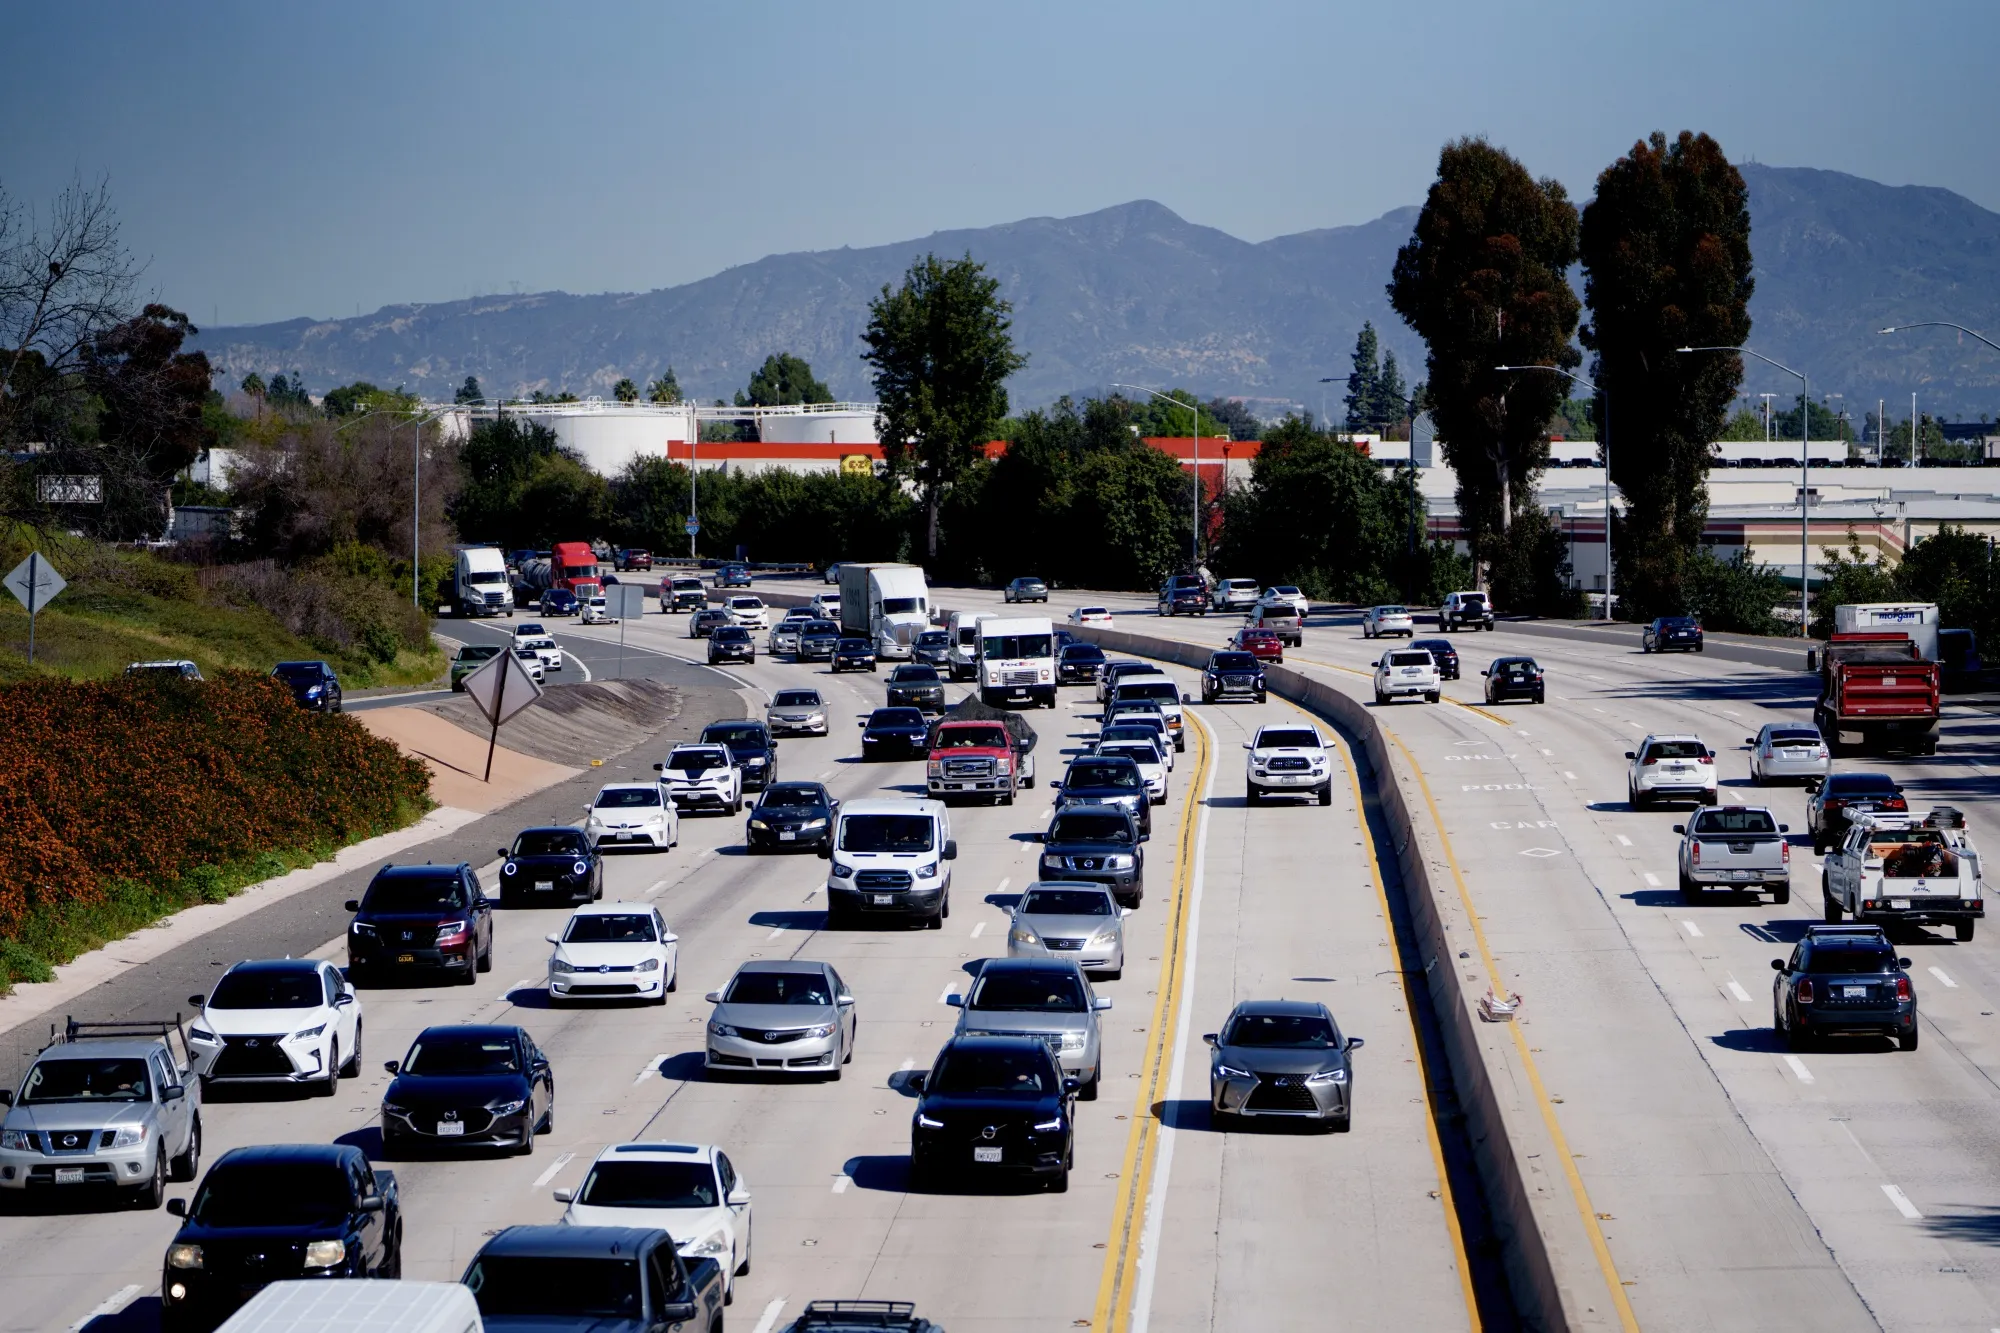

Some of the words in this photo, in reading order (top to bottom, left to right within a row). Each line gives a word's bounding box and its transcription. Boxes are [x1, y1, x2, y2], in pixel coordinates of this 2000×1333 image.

[1879, 612, 1915, 622] morgan
[1461, 783, 1545, 792] POOL
[1490, 820, 1557, 829] CAR
